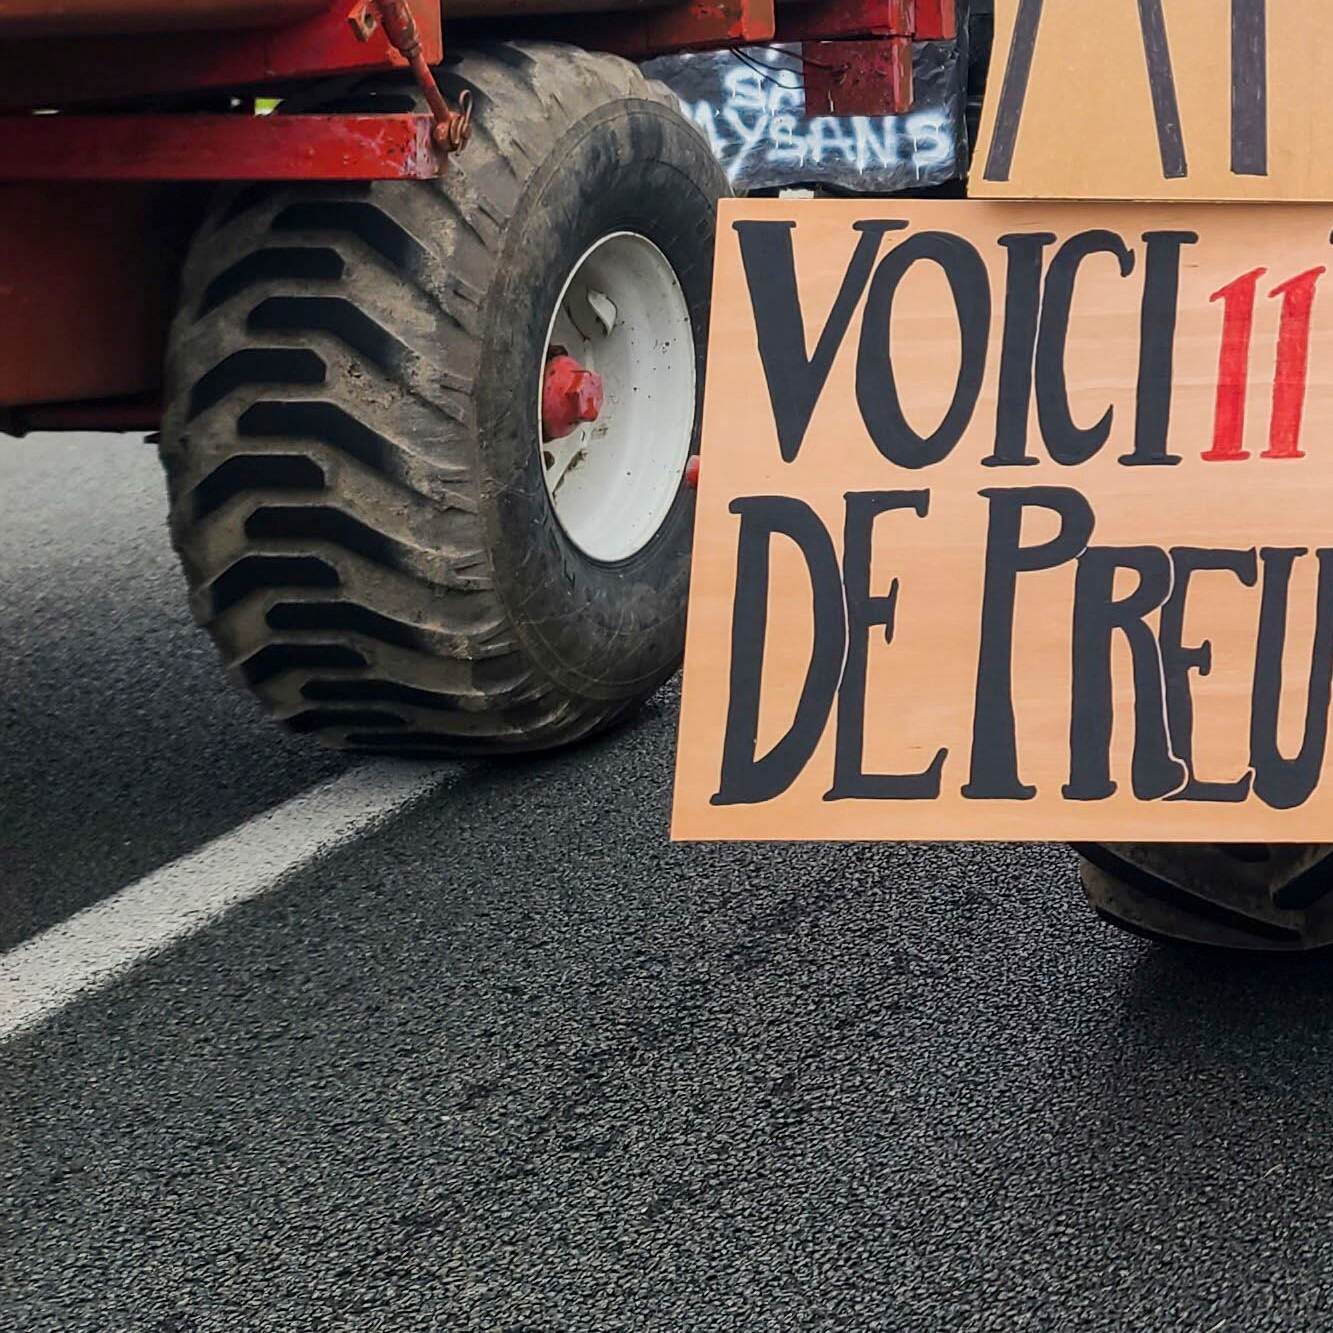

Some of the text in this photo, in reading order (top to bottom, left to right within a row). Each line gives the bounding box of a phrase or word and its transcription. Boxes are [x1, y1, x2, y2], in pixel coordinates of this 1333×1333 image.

[679, 97, 955, 181] AYSANS
[732, 220, 1198, 469] VOICI
[1201, 266, 1325, 461] 11
[710, 489, 948, 806] DE
